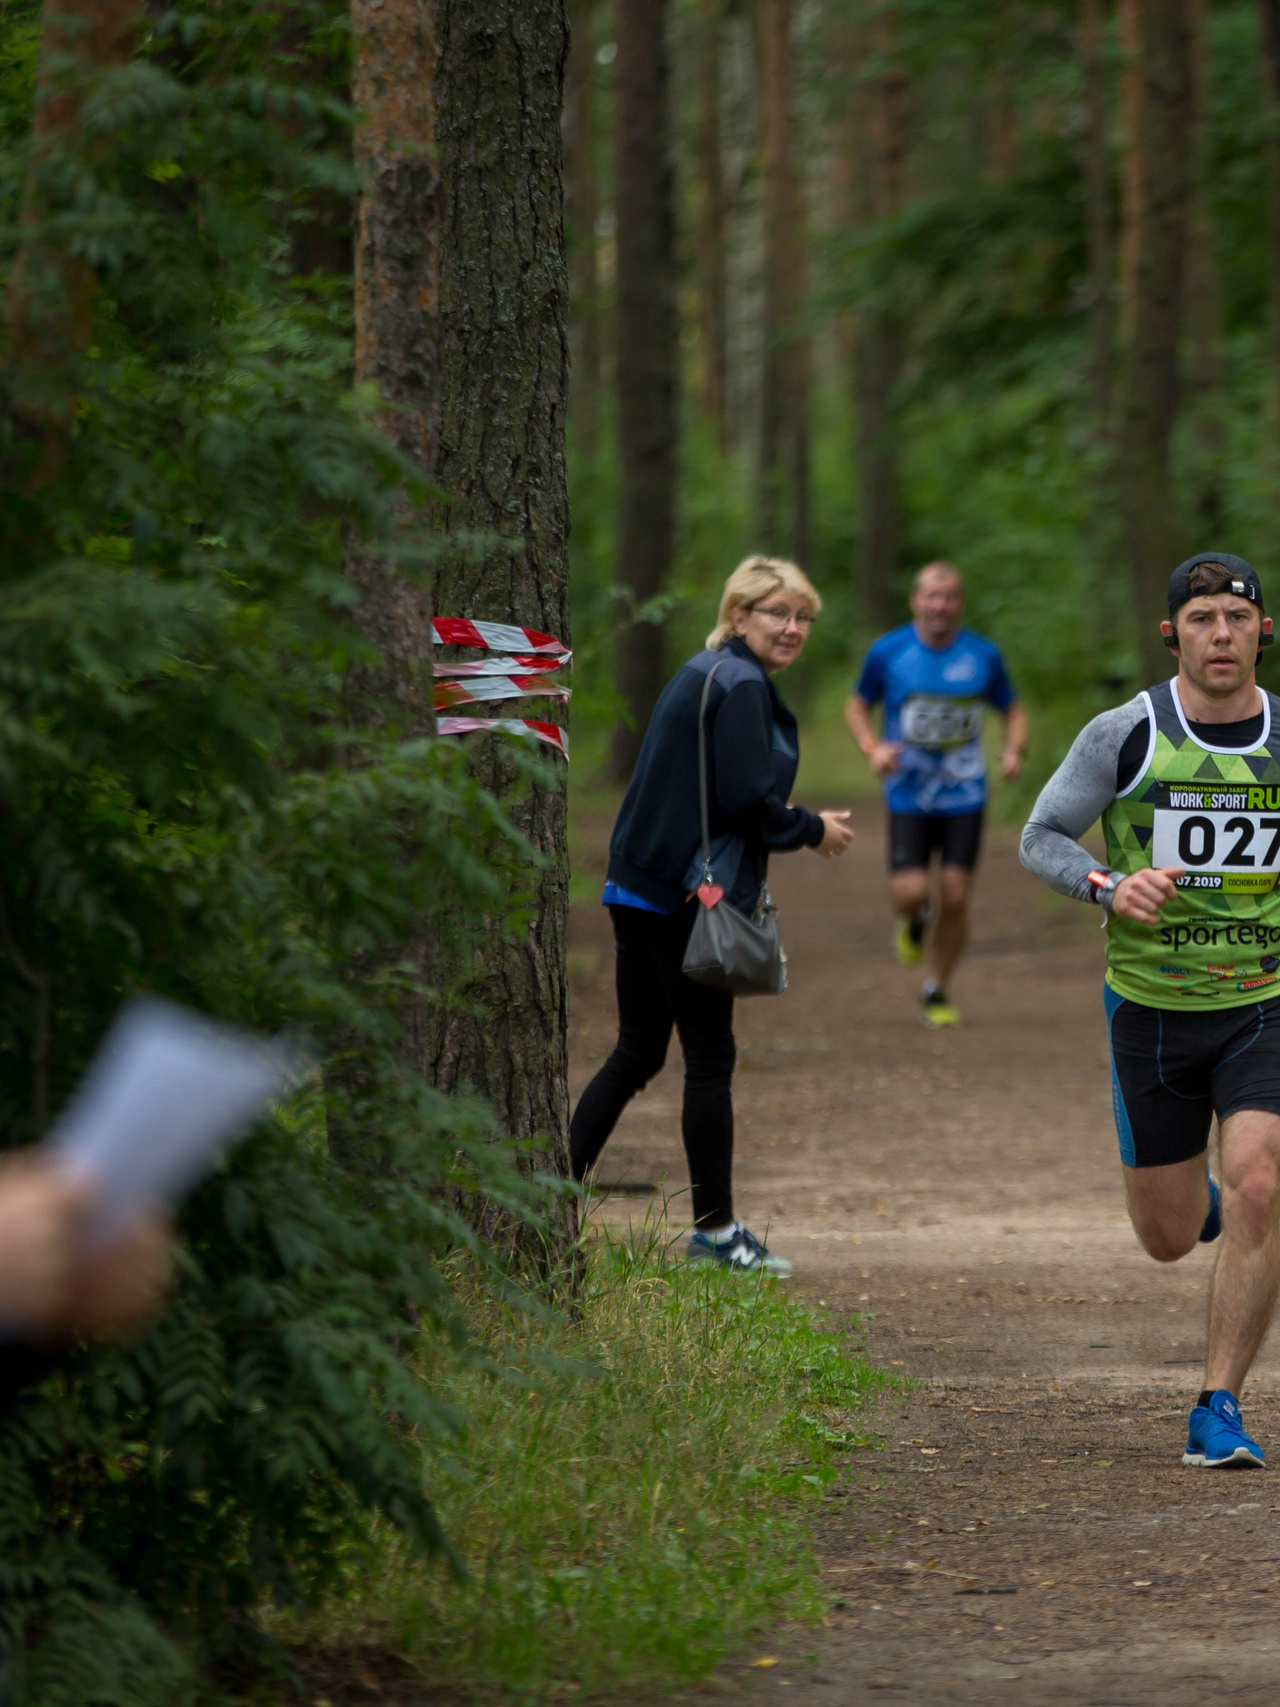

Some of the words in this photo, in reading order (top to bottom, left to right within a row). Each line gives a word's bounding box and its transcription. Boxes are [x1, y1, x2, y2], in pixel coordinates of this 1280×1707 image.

[1170, 785, 1228, 793] КОРПОРАТИВНЫЙ
[1170, 792, 1248, 809] WORK&SPORT
[1228, 878, 1258, 887] СОСНОВКА
[1258, 878, 1272, 887] ПАРК
